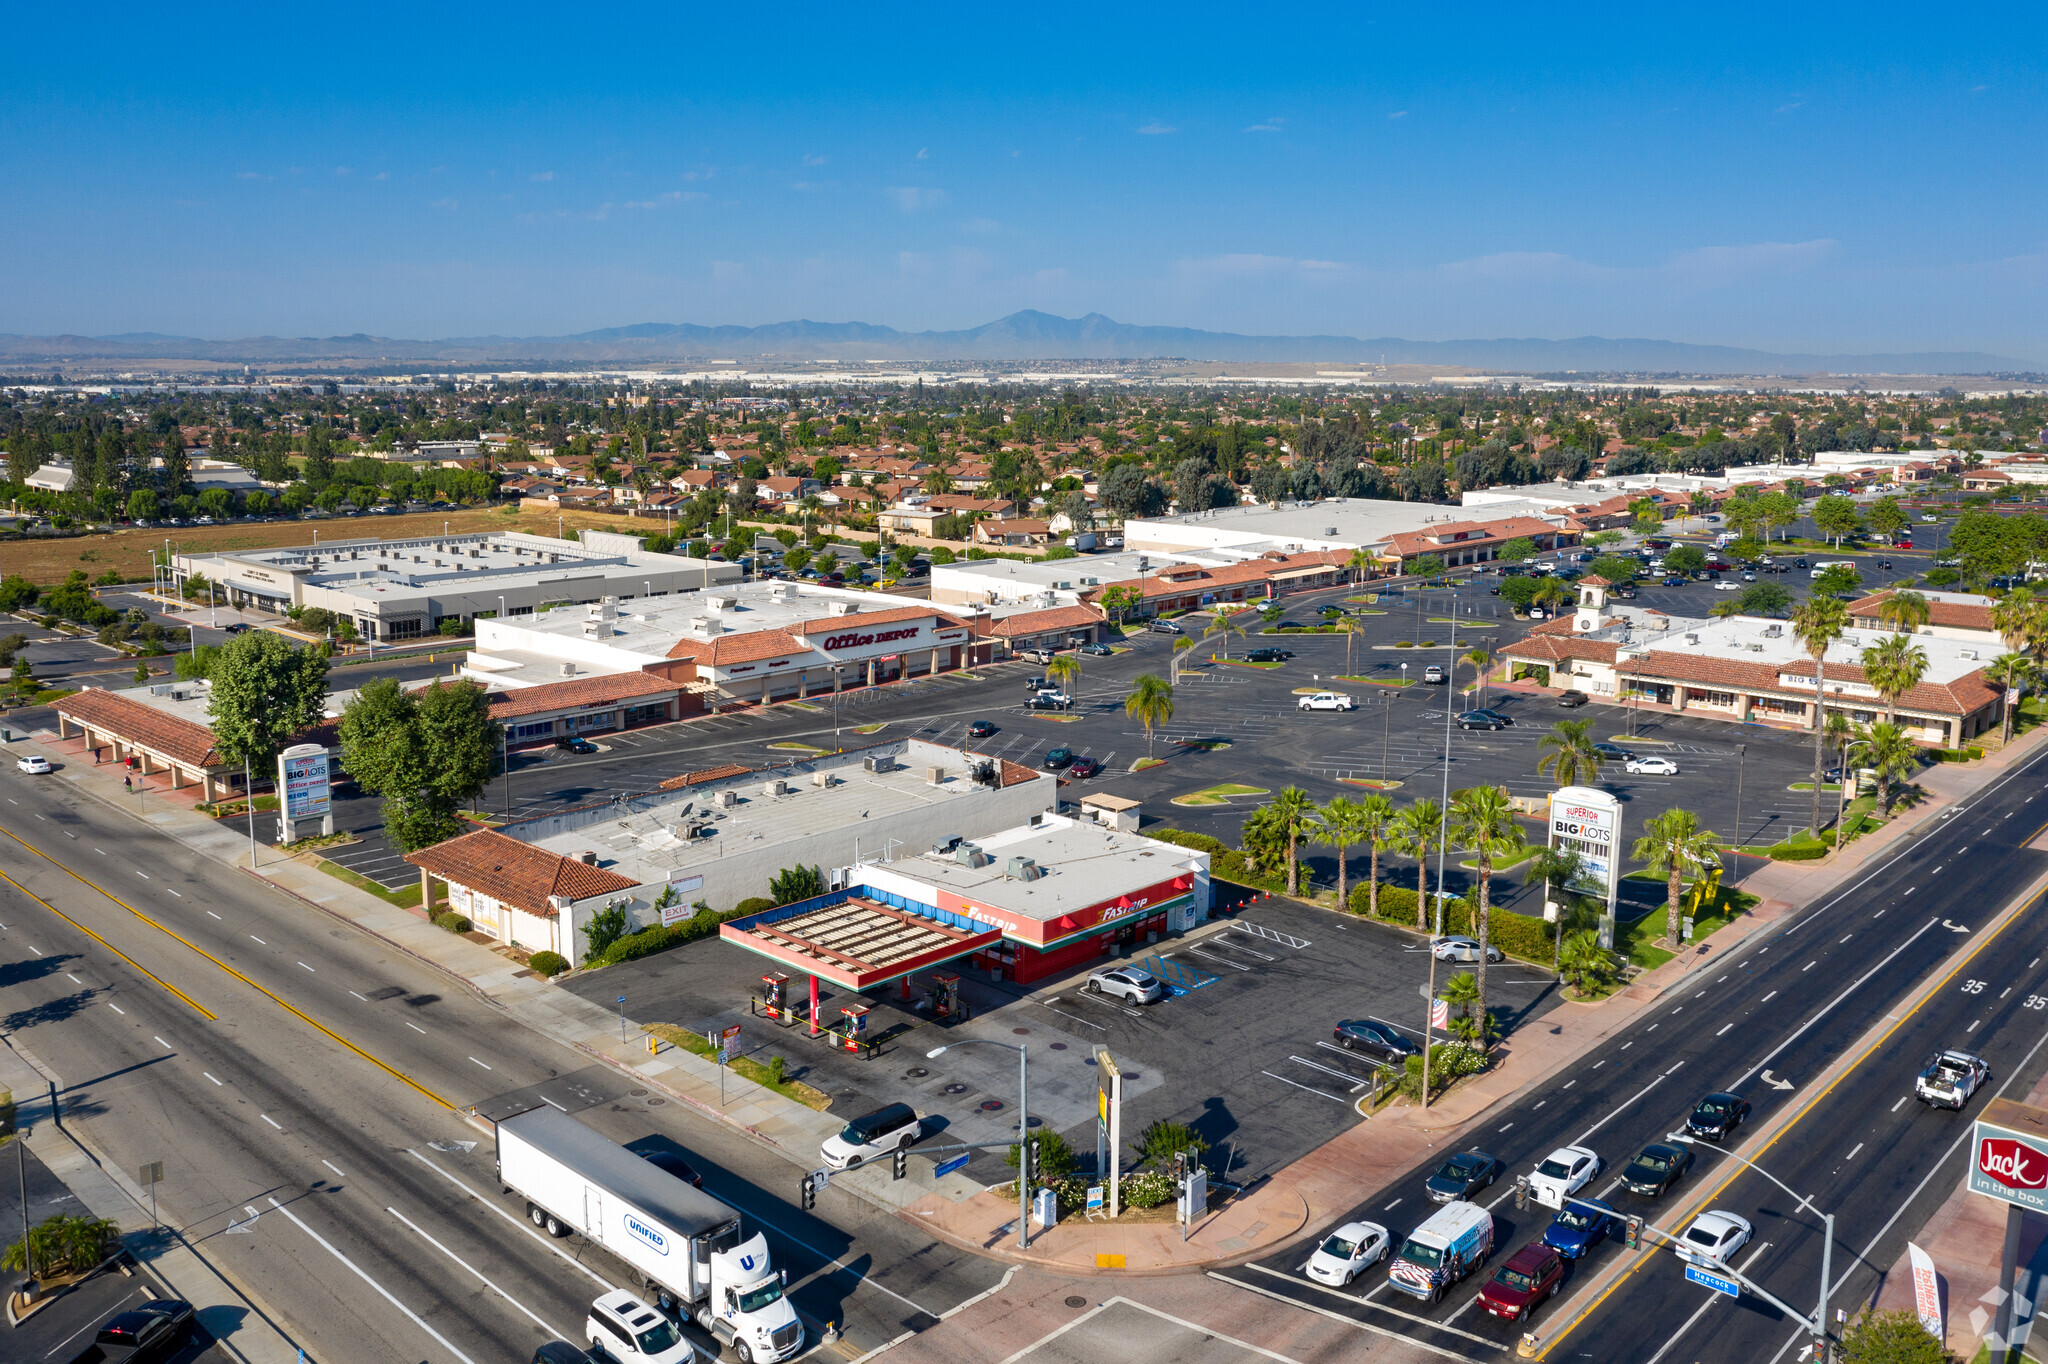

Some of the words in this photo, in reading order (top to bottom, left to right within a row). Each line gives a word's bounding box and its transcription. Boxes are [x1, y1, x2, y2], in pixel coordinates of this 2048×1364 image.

[824, 633, 874, 651] Office
[874, 627, 919, 643] DEPOT
[1787, 675, 1805, 684] BIG
[287, 781, 308, 790] Office
[308, 778, 327, 786] DEPOT
[1566, 807, 1599, 820] SUPERIOR
[665, 904, 689, 917] EXIT
[967, 906, 1018, 932] FASTRIP
[1961, 979, 1987, 995] 35
[2023, 994, 2048, 1010] 35
[1981, 1141, 2045, 1185] Jack
[1977, 1178, 1989, 1190] in
[1992, 1182, 2016, 1197] the
[2018, 1190, 2044, 1206] box
[629, 1219, 664, 1246] UNIFIED
[1694, 1271, 1729, 1289] Heacock
